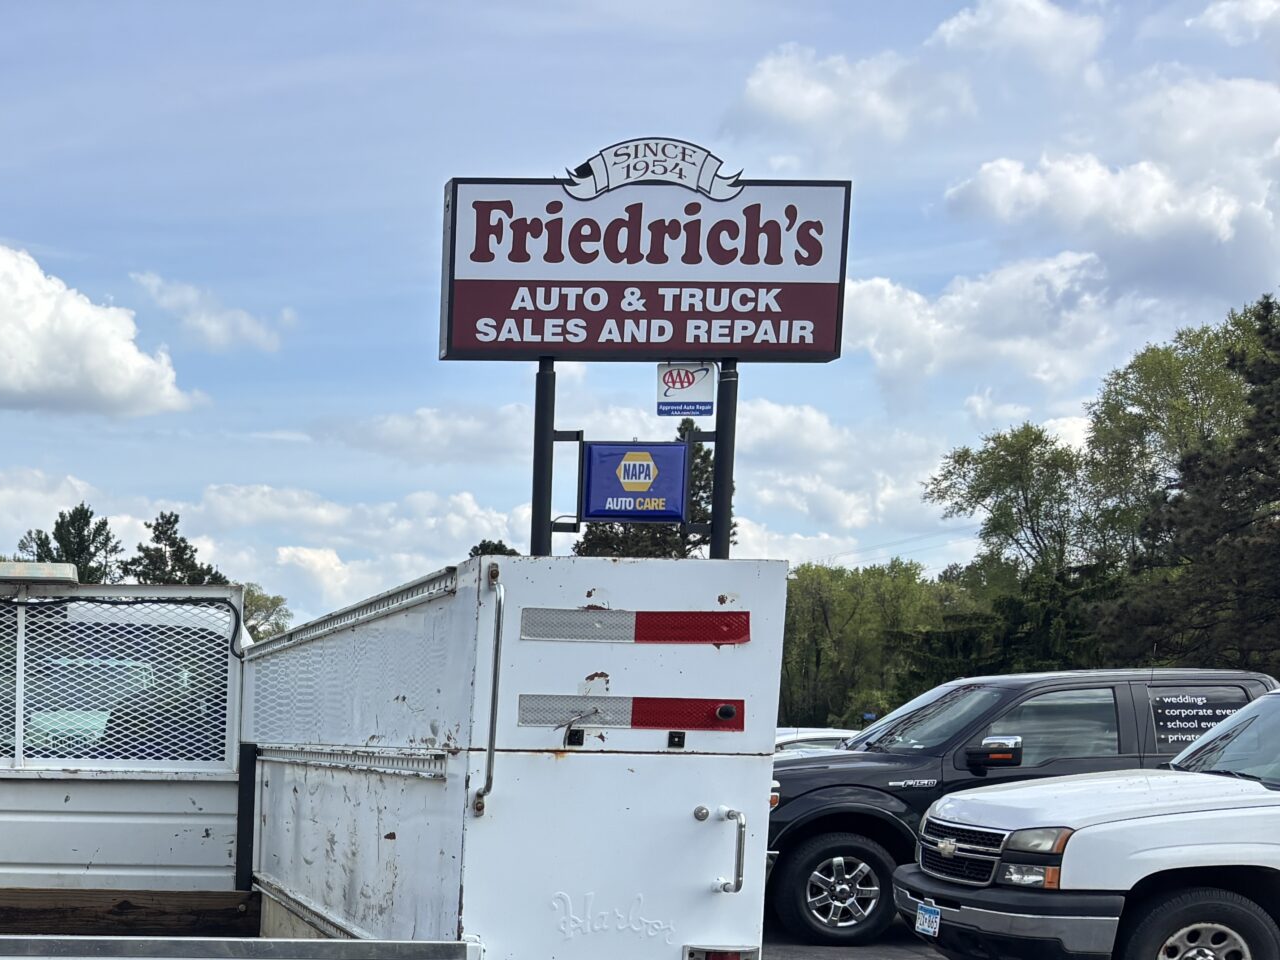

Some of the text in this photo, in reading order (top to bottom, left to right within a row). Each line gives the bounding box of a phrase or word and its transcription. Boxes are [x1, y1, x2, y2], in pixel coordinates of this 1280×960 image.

[612, 142, 698, 167] SINCE
[622, 159, 687, 181] 1954
[469, 199, 824, 266] Friedrich's
[511, 286, 782, 313] AUTO & TRUCK
[475, 318, 815, 344] SALES AND REPAIR
[664, 368, 695, 389] AAA
[623, 463, 651, 481] NAPA
[605, 497, 666, 510] AUTO CARE
[1162, 695, 1207, 705] weddings
[1165, 708, 1213, 717] corporate
[1167, 720, 1198, 728] school
